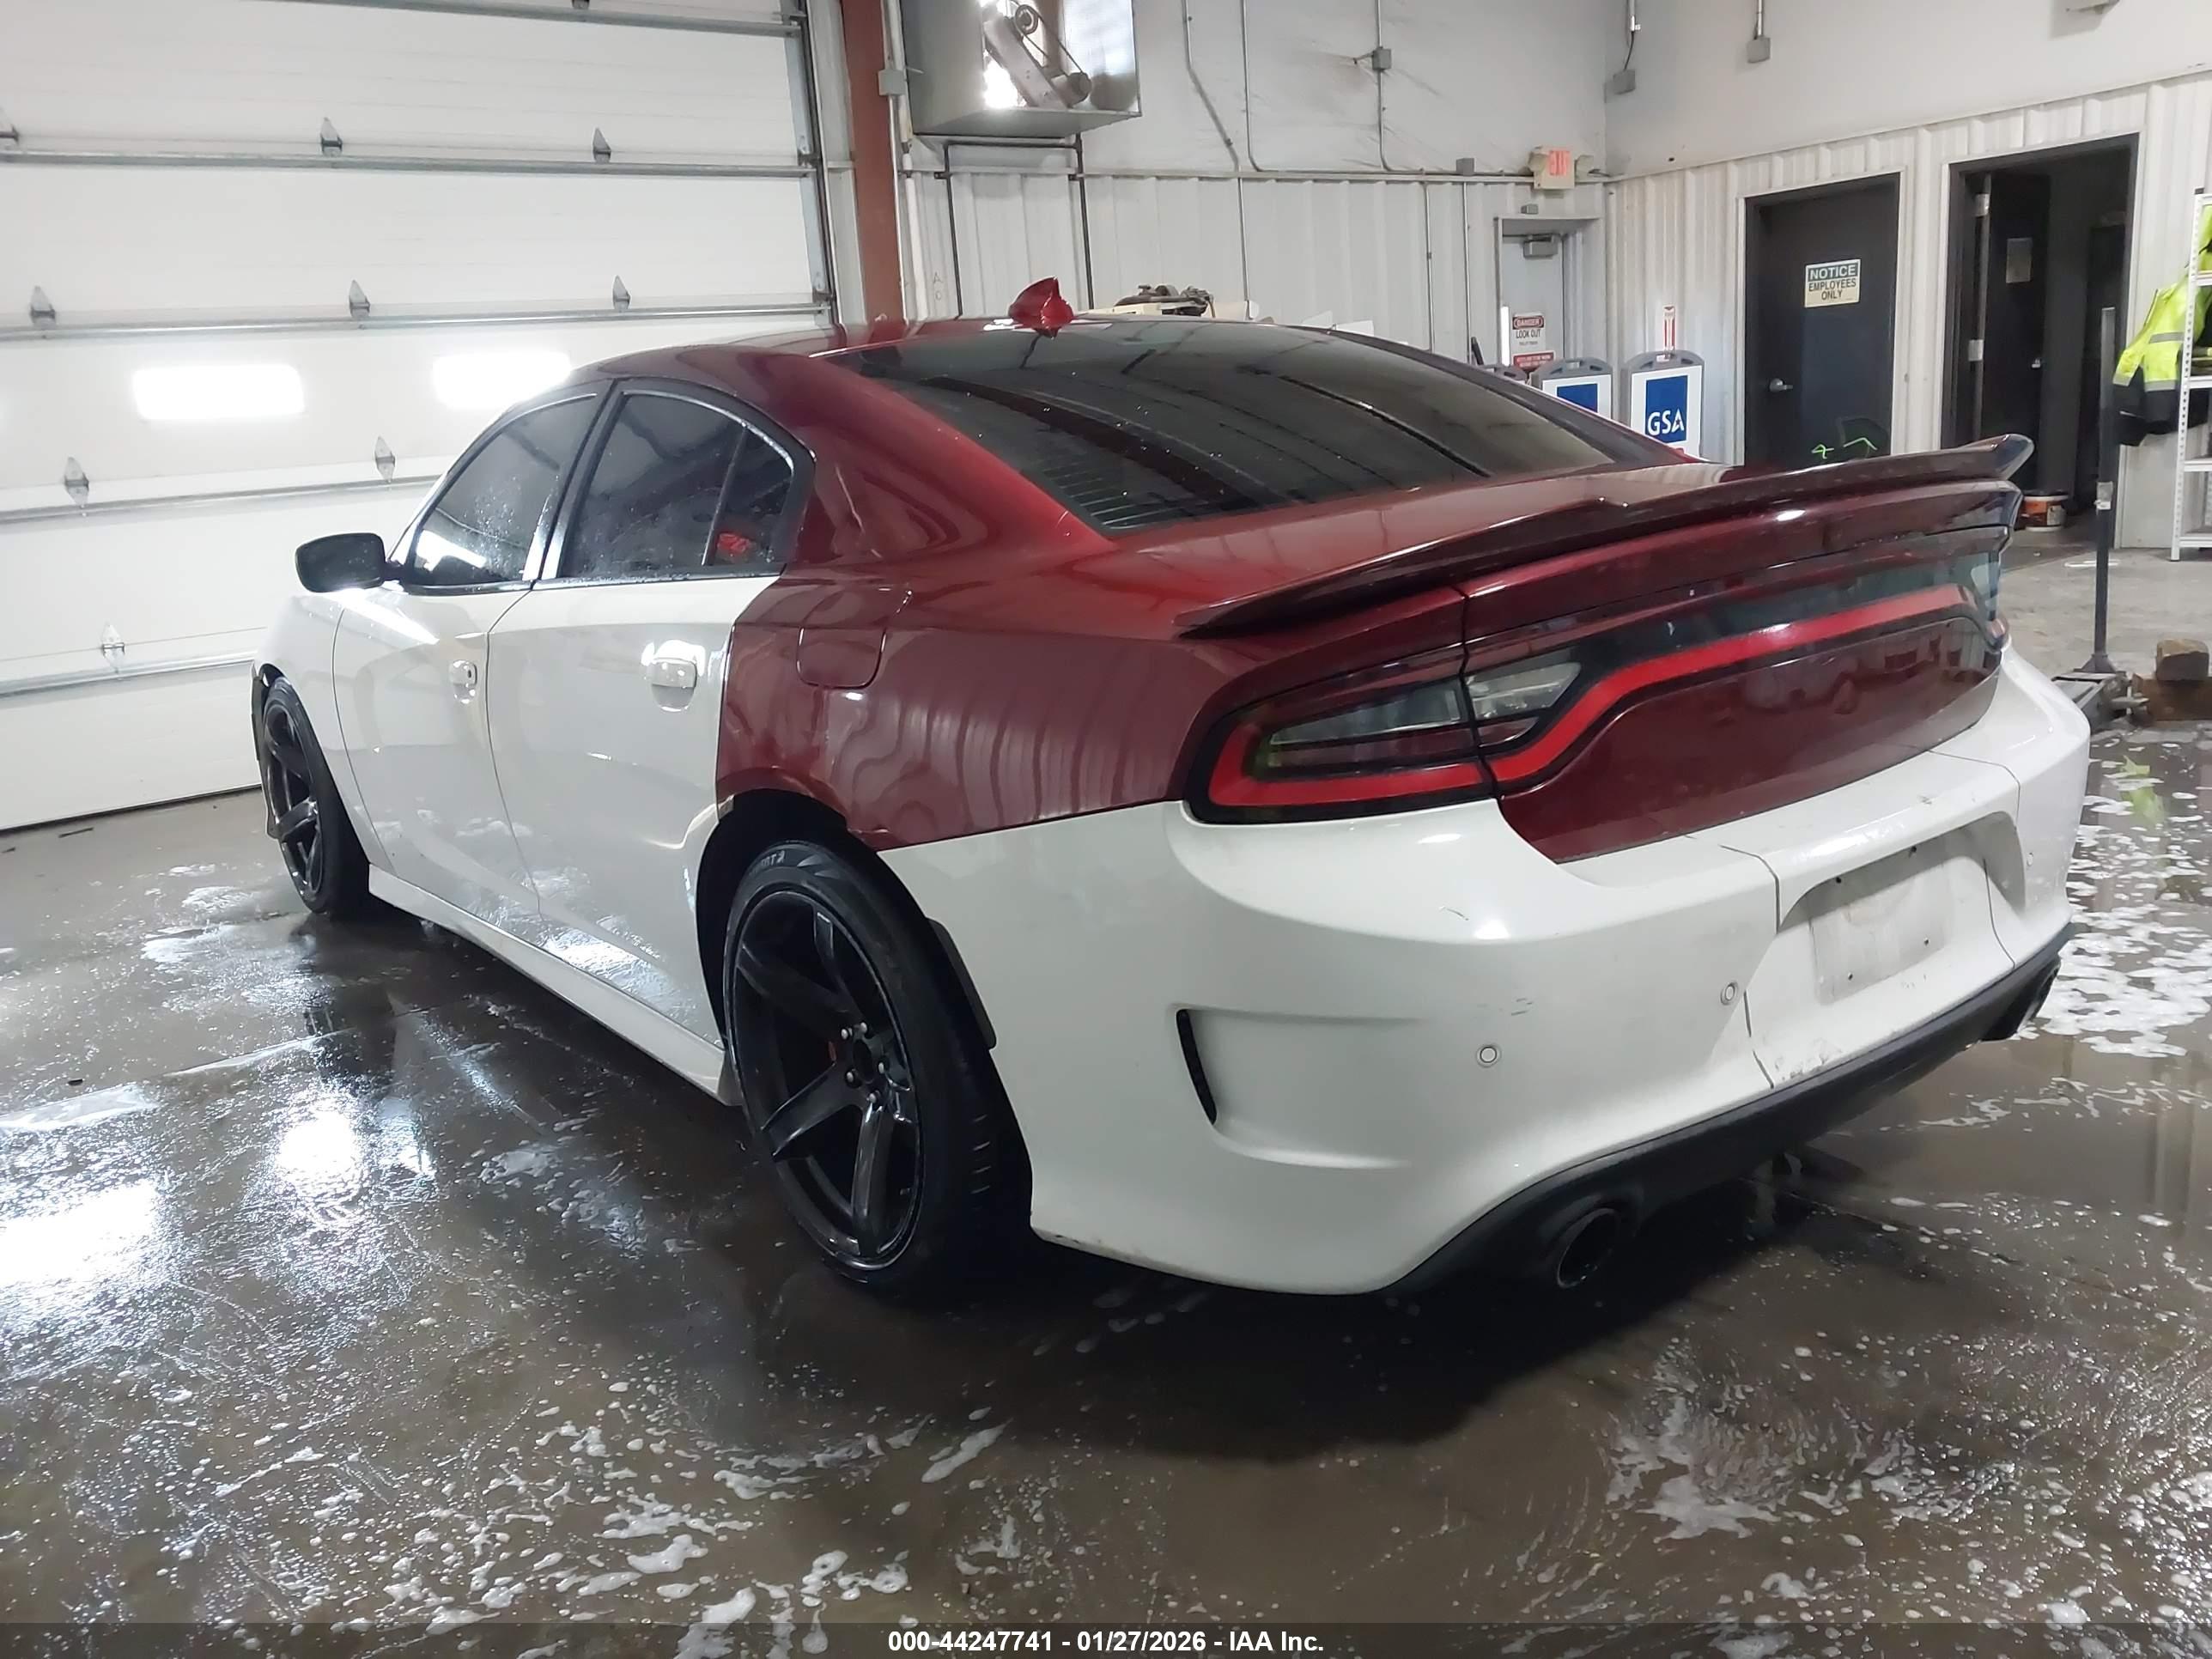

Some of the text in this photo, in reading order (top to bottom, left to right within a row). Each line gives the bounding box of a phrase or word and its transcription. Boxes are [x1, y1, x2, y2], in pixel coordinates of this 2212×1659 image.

[1809, 264, 1856, 280] NOTICE
[1808, 277, 1856, 292] EMPLOYEES
[1821, 289, 1843, 301] ONLY
[1516, 329, 1540, 338] LOOK OUT
[1647, 408, 1685, 436] GSA
